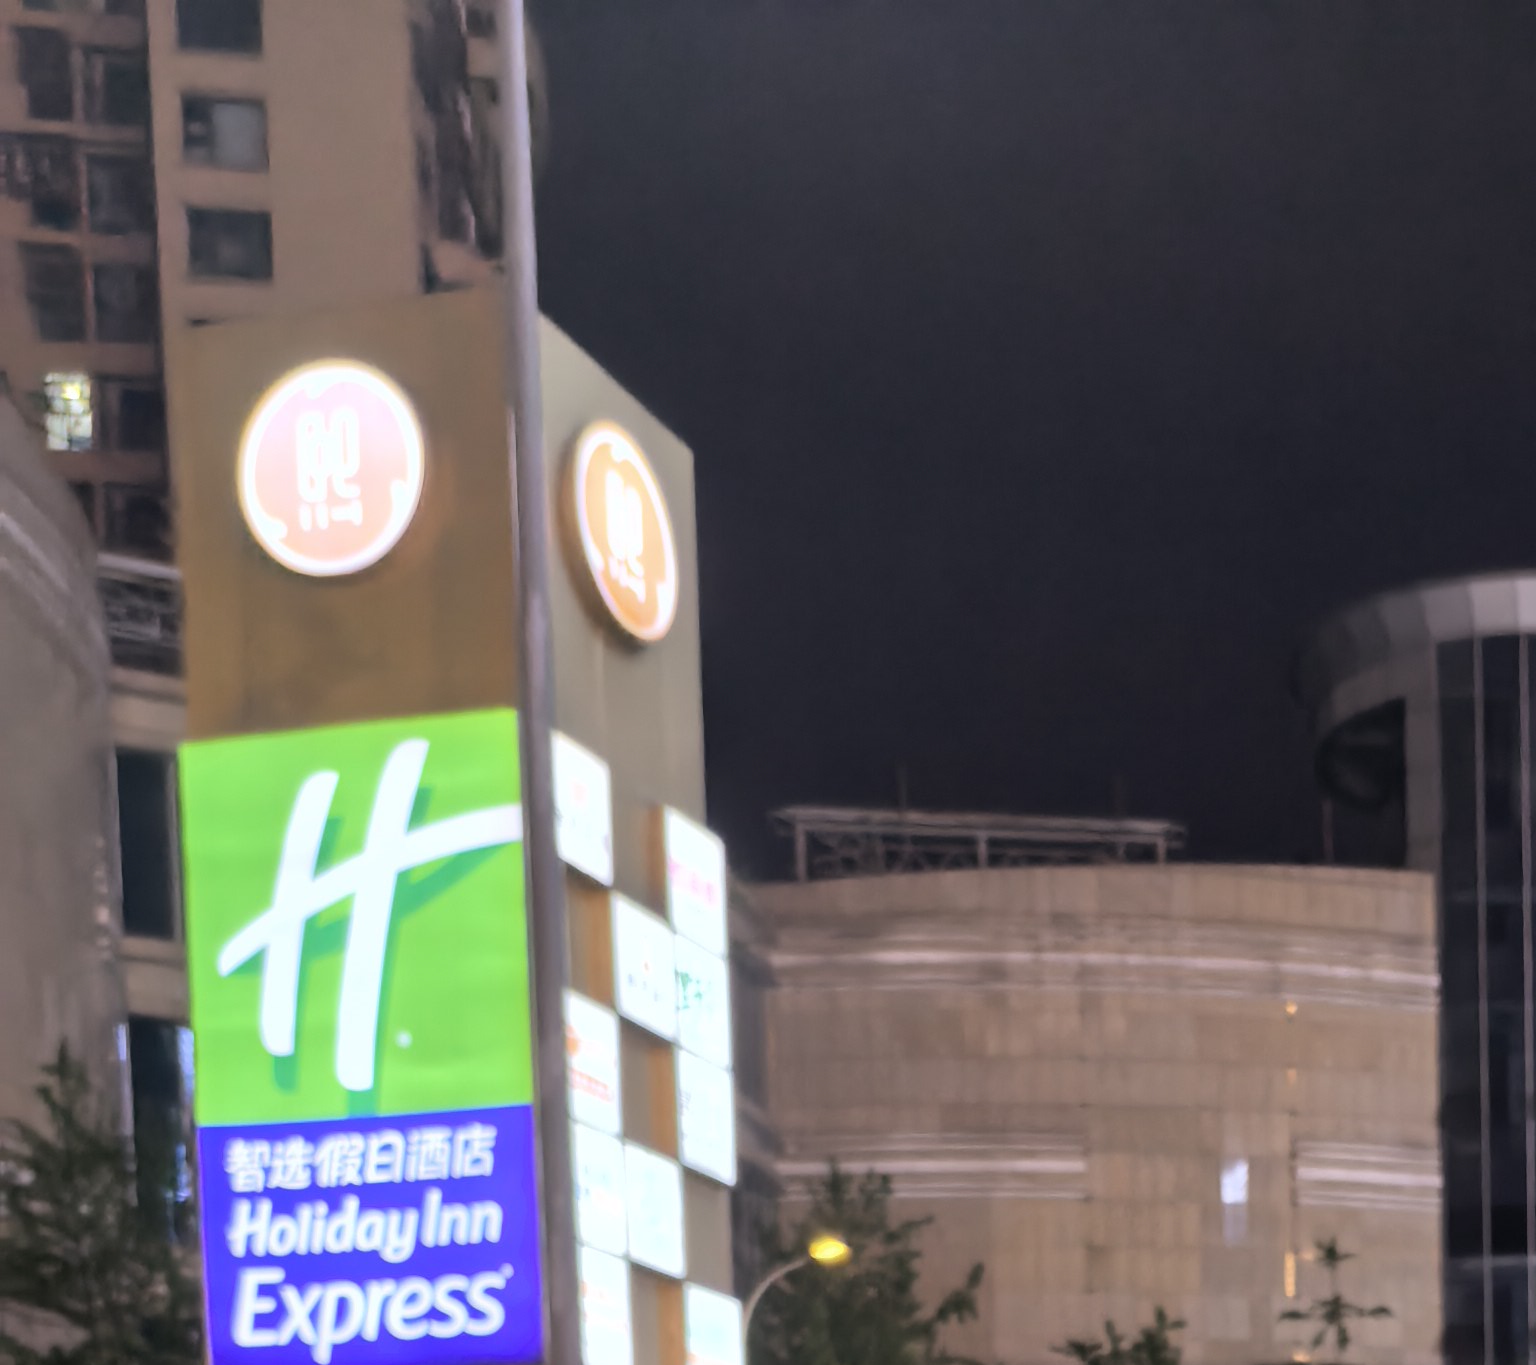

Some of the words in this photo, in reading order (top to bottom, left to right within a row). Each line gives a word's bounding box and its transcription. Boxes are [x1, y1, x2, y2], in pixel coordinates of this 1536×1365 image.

[224, 1122, 498, 1193] 智选假日酒店
[225, 1193, 419, 1264] Holiday
[421, 1186, 503, 1248] Inn
[230, 1265, 505, 1365] Express
